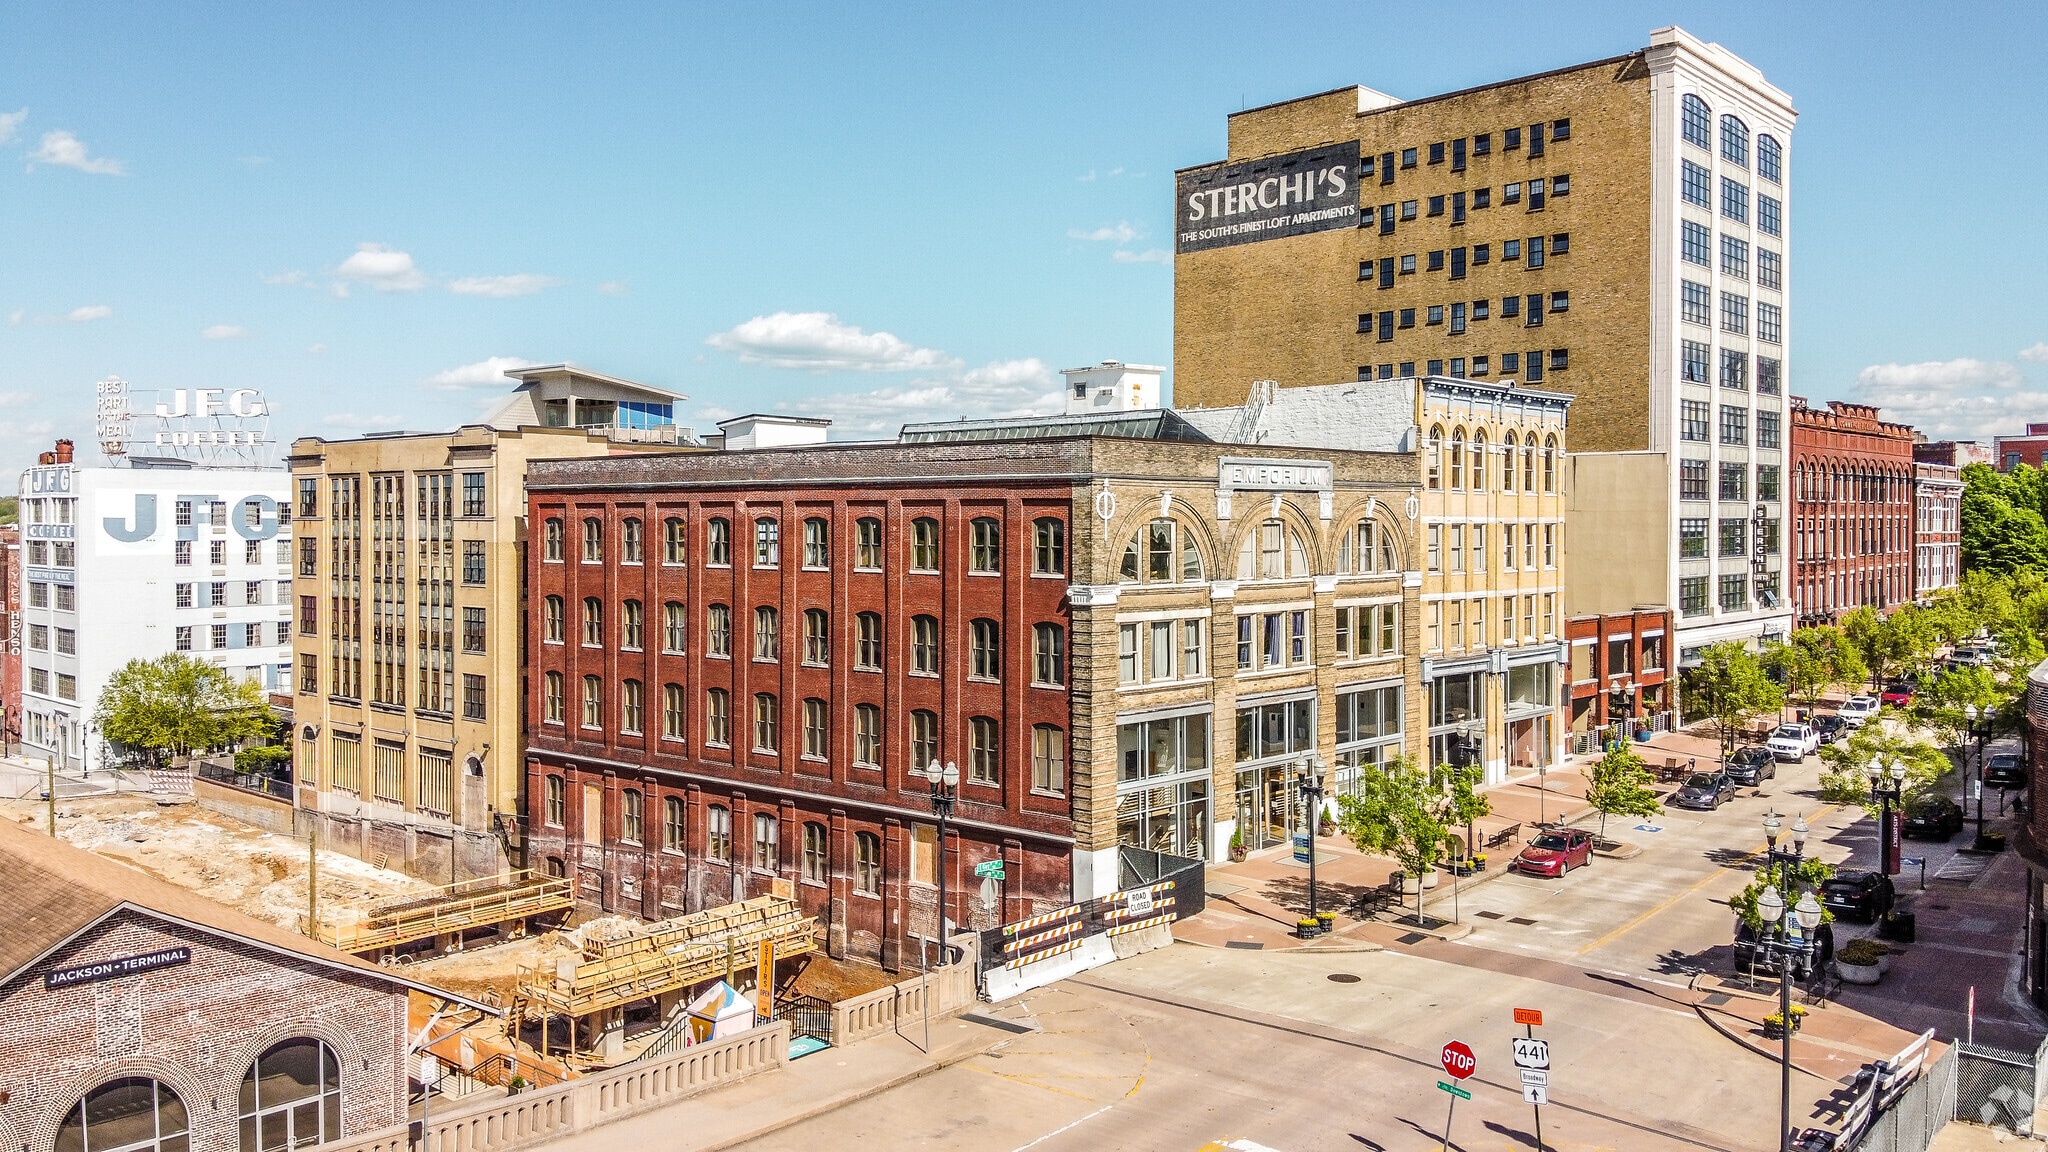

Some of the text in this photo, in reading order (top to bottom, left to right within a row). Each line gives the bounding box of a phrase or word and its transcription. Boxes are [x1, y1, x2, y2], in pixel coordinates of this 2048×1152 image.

[1189, 165, 1346, 221] STERCHI'S
[1181, 204, 1355, 243] THE SOUTH'S FINEST LOFT APARTMENTS
[97, 381, 129, 394] BEST
[97, 396, 129, 410] PART
[156, 388, 263, 417] JFG
[96, 425, 131, 437] MEAL
[156, 431, 264, 447] COFFEE
[33, 469, 70, 492] JFG
[1232, 467, 1321, 486] EMPORIUM
[103, 494, 279, 543] JFG
[1756, 509, 1765, 572] STERCHI
[1132, 892, 1147, 901] ROAD
[1131, 901, 1151, 911] CLOSED
[50, 950, 187, 984] JACKSON TERMINAL
[1516, 1012, 1540, 1022] DETOUR
[1443, 1049, 1474, 1071] STOP
[1518, 1044, 1545, 1061] 441
[1522, 1073, 1544, 1083] Broadway
